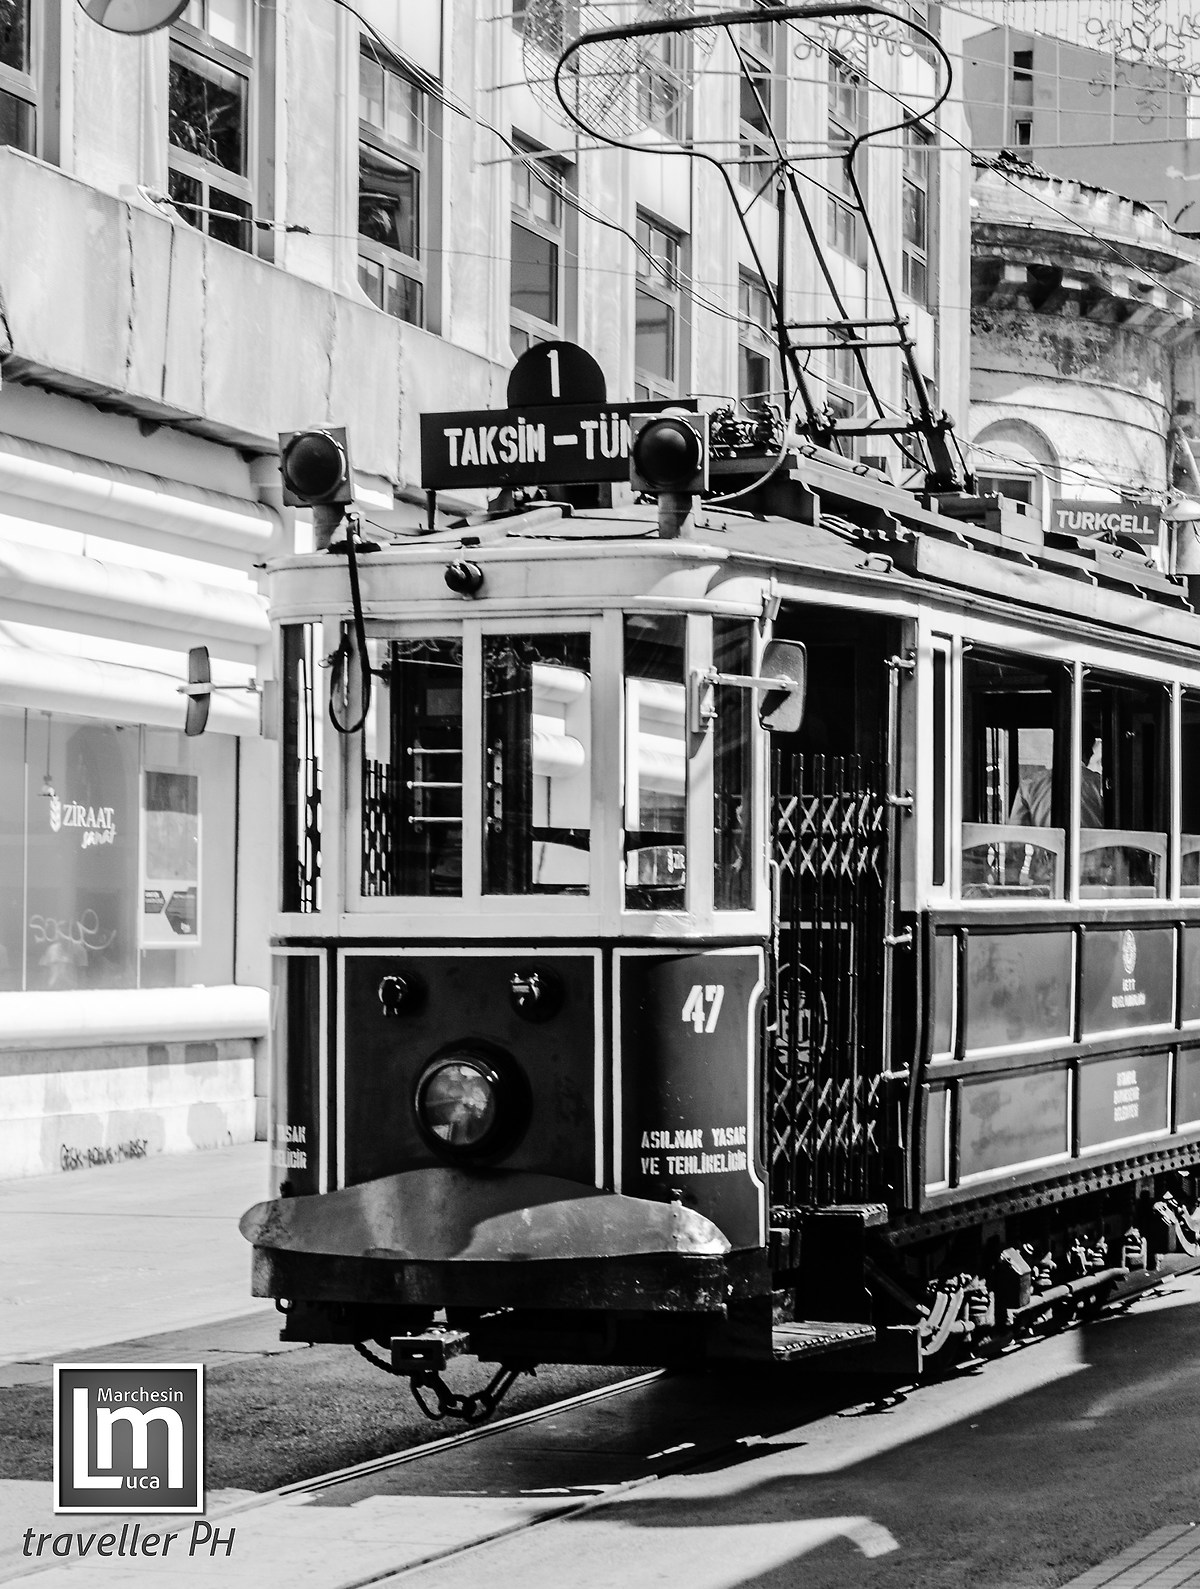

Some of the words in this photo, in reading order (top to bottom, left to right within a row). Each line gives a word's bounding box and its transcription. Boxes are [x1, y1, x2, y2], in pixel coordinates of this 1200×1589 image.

[547, 349, 561, 398] 1
[1056, 509, 1155, 535] TURKCELL
[63, 800, 115, 829] ZİRAAT
[681, 984, 724, 1034] 47
[711, 1126, 747, 1148] YASAK
[640, 1157, 660, 1175] VE
